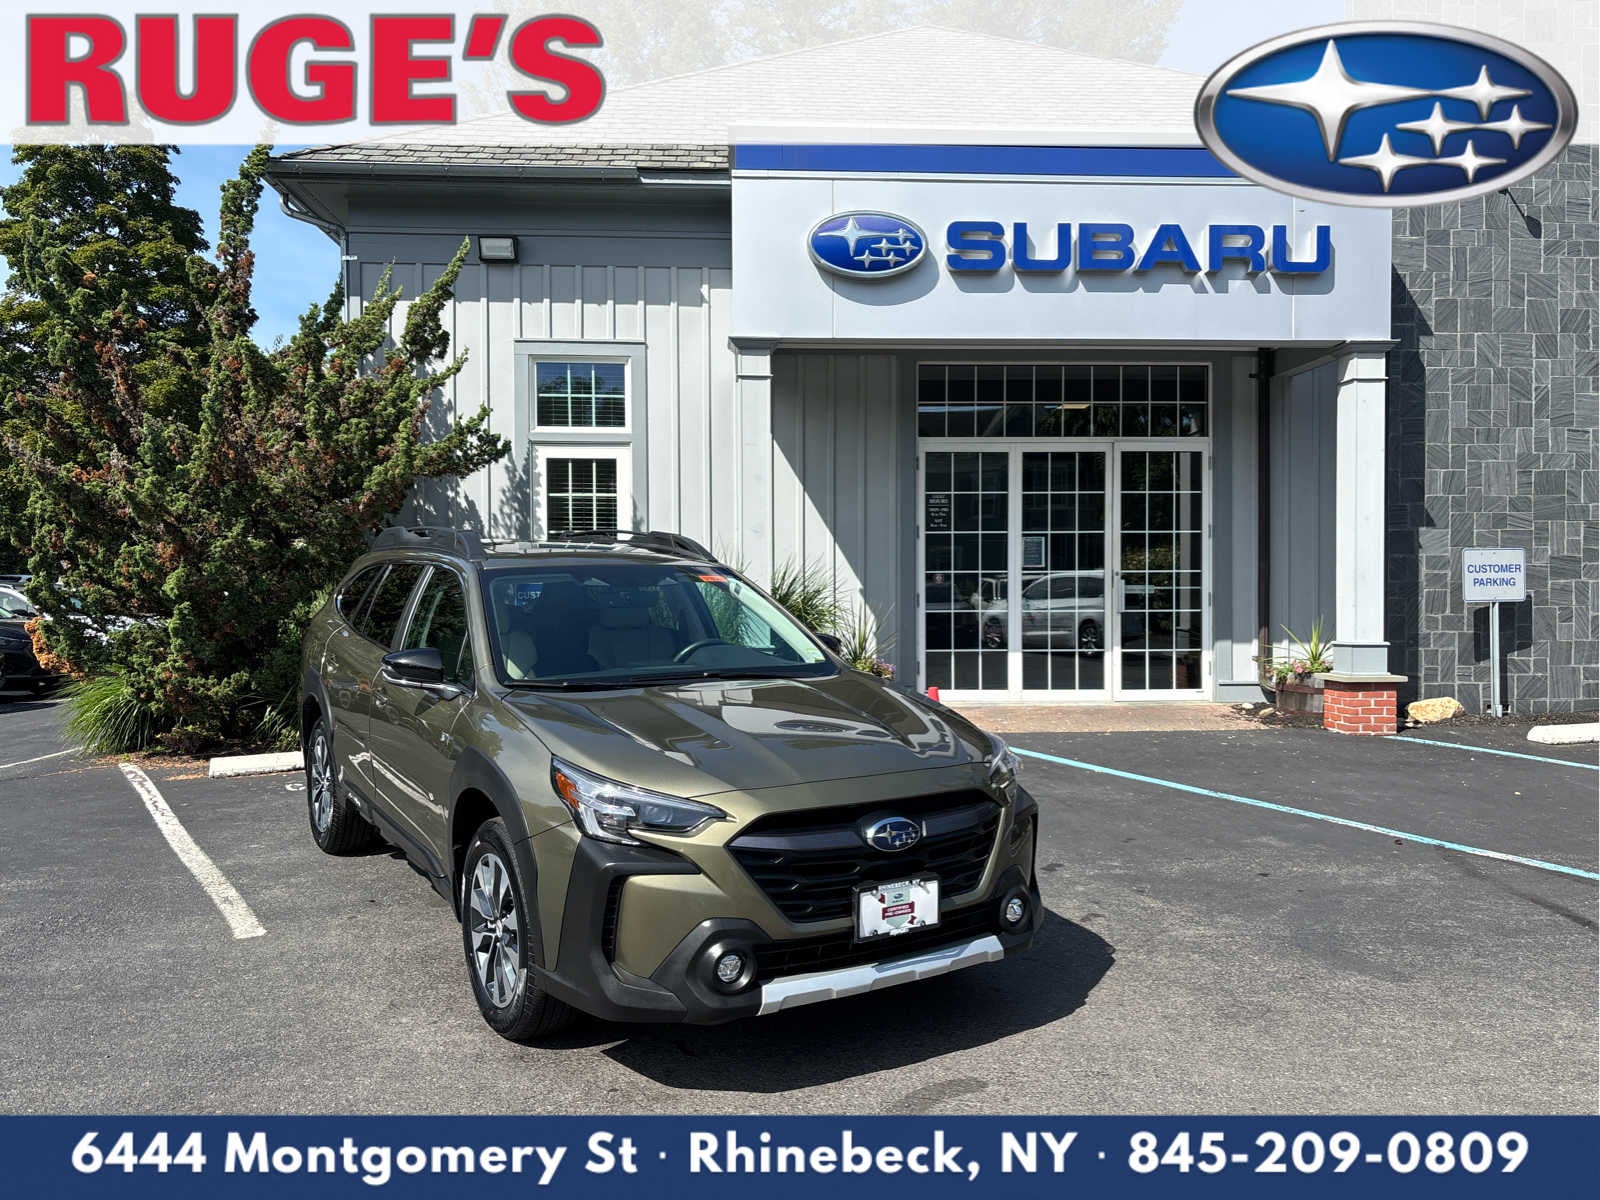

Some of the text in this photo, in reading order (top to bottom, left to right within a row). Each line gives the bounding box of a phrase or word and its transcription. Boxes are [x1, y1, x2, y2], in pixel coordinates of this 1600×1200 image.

[946, 221, 1333, 276] SUBARU
[1467, 563, 1521, 573] CUSTOMER
[1473, 577, 1516, 587] PARKING
